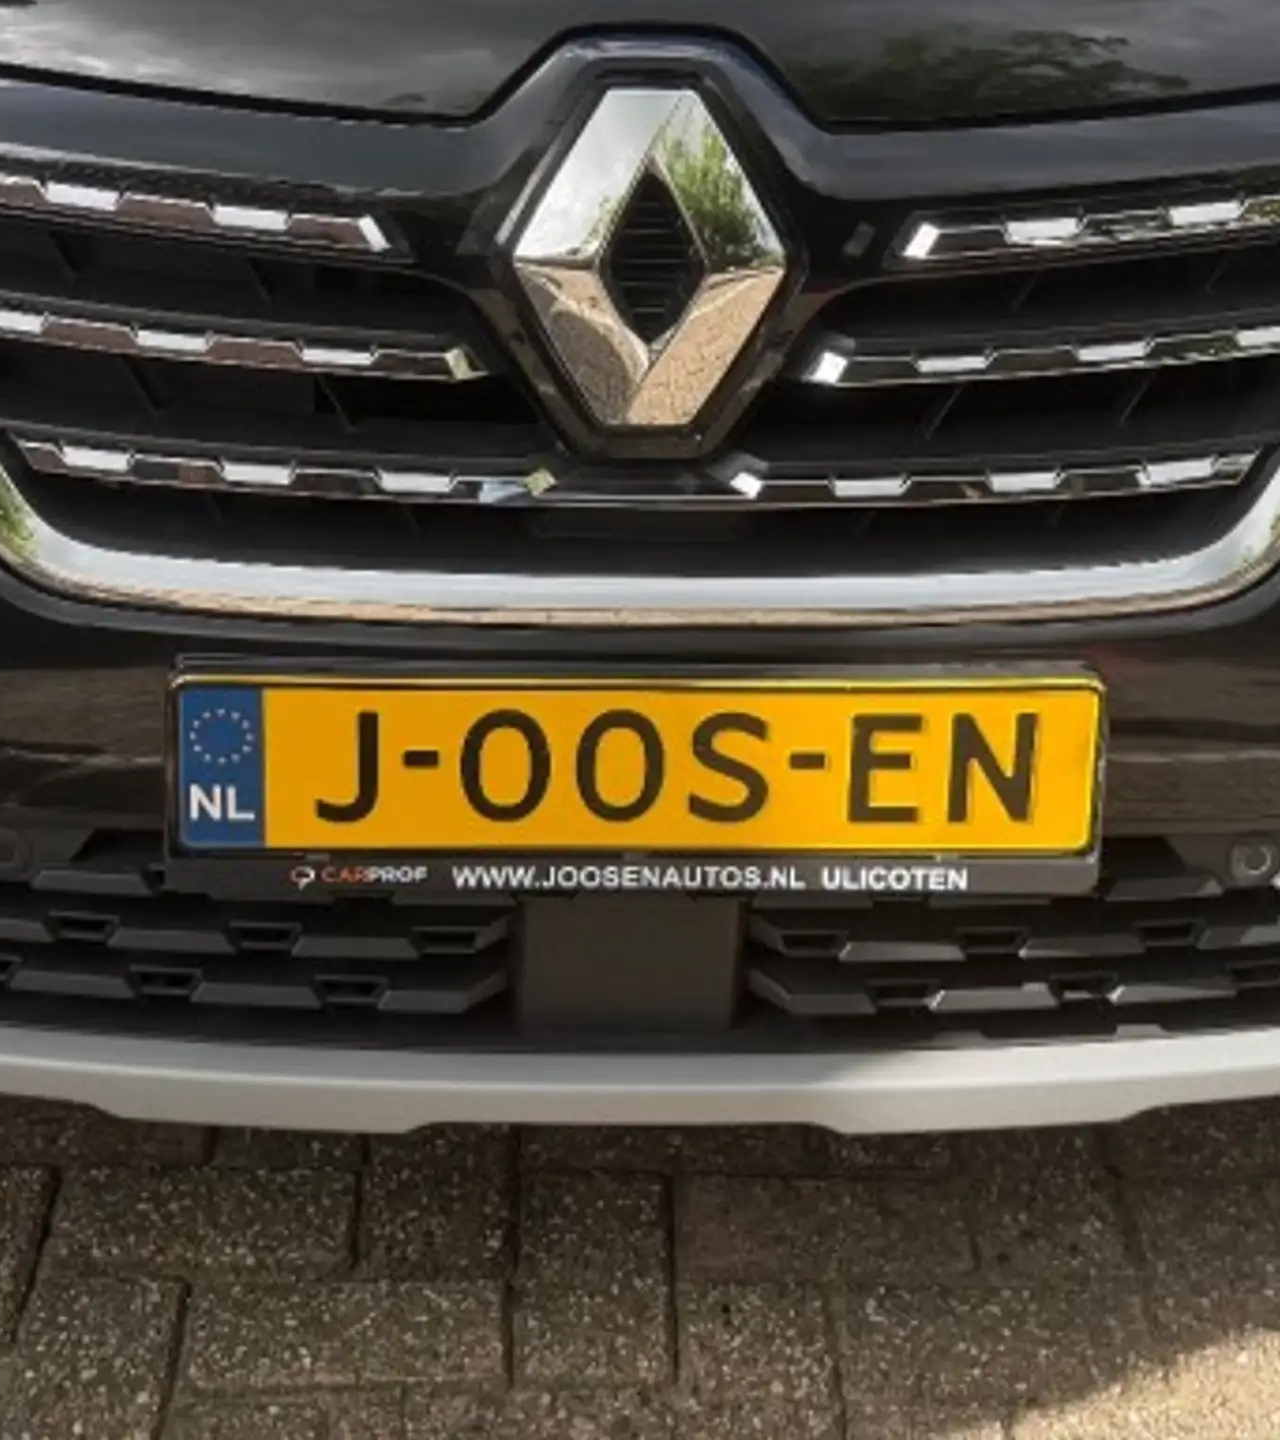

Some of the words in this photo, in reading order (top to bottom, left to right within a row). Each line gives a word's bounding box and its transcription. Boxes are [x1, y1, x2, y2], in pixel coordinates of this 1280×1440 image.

[315, 708, 1039, 824] J-OOS-EN
[189, 783, 256, 822] NL
[321, 865, 428, 884] CARPROF
[452, 865, 807, 890] WWW.JOOSENAUTOS.NL
[822, 866, 968, 891] ULICOTEN
